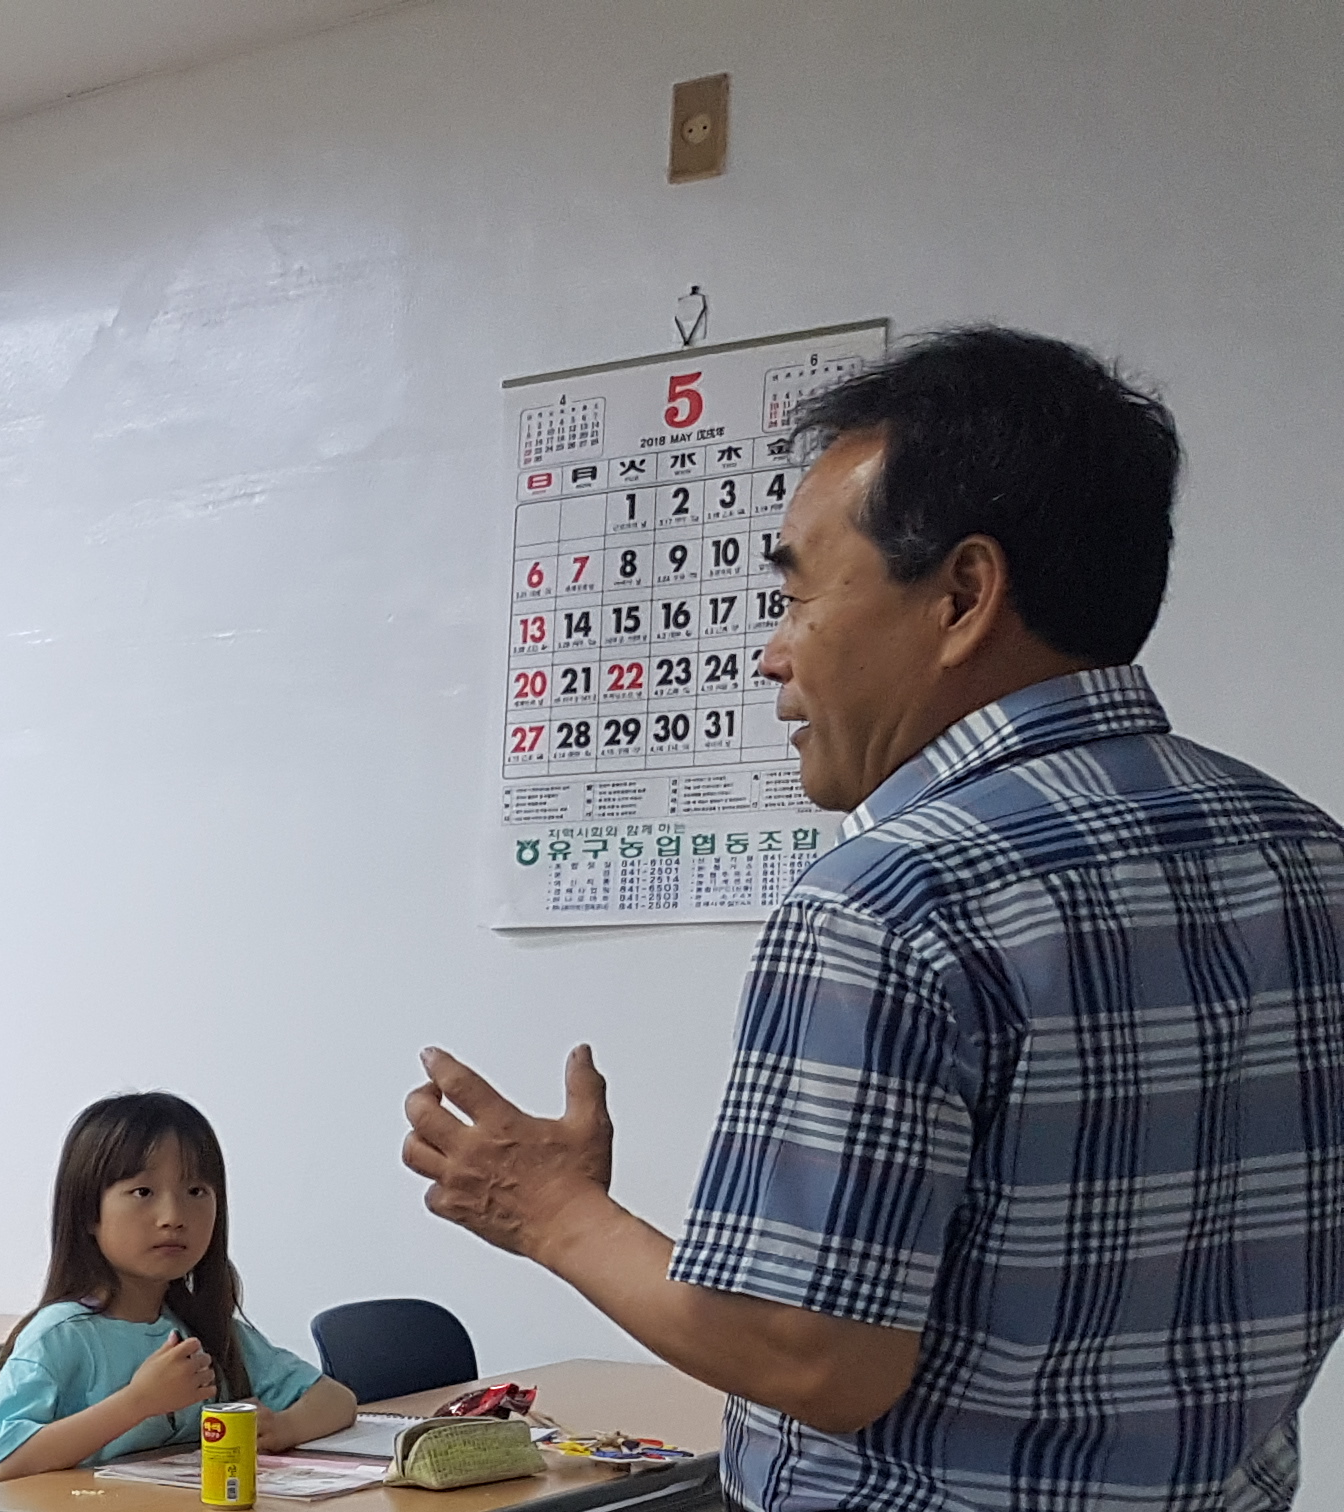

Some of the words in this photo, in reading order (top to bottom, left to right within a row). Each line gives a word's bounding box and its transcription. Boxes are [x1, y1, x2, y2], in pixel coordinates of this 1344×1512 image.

[810, 353, 818, 367] 6
[664, 371, 703, 428] 5
[640, 436, 666, 448] 2018
[670, 432, 693, 444] MAY
[527, 472, 552, 490] 日
[572, 466, 597, 484] 月
[619, 459, 646, 476] 火
[670, 452, 697, 469] 水
[717, 446, 743, 463] 木
[766, 438, 792, 457] 金
[626, 493, 636, 520] 1
[672, 487, 690, 516] 2
[719, 479, 736, 509] 3
[766, 473, 786, 501] 4
[527, 562, 544, 588] 6
[572, 556, 590, 583] 7
[620, 550, 637, 578] 8
[669, 545, 688, 573] 9
[712, 537, 740, 567] 10
[520, 616, 546, 644] 13
[564, 611, 592, 639] 14
[612, 606, 641, 634] 15
[662, 601, 691, 630] 16
[709, 595, 738, 625] 17
[756, 590, 785, 620] 18
[513, 670, 547, 699] 20
[561, 667, 591, 695] 21
[607, 662, 644, 692] 22
[656, 657, 692, 687] 23
[704, 653, 739, 683] 24
[511, 725, 545, 754] 27
[556, 721, 591, 749] 28
[603, 718, 641, 747] 29
[653, 713, 690, 743] 30
[704, 710, 735, 739] 31
[548, 828, 820, 860] 유구농업협동조합
